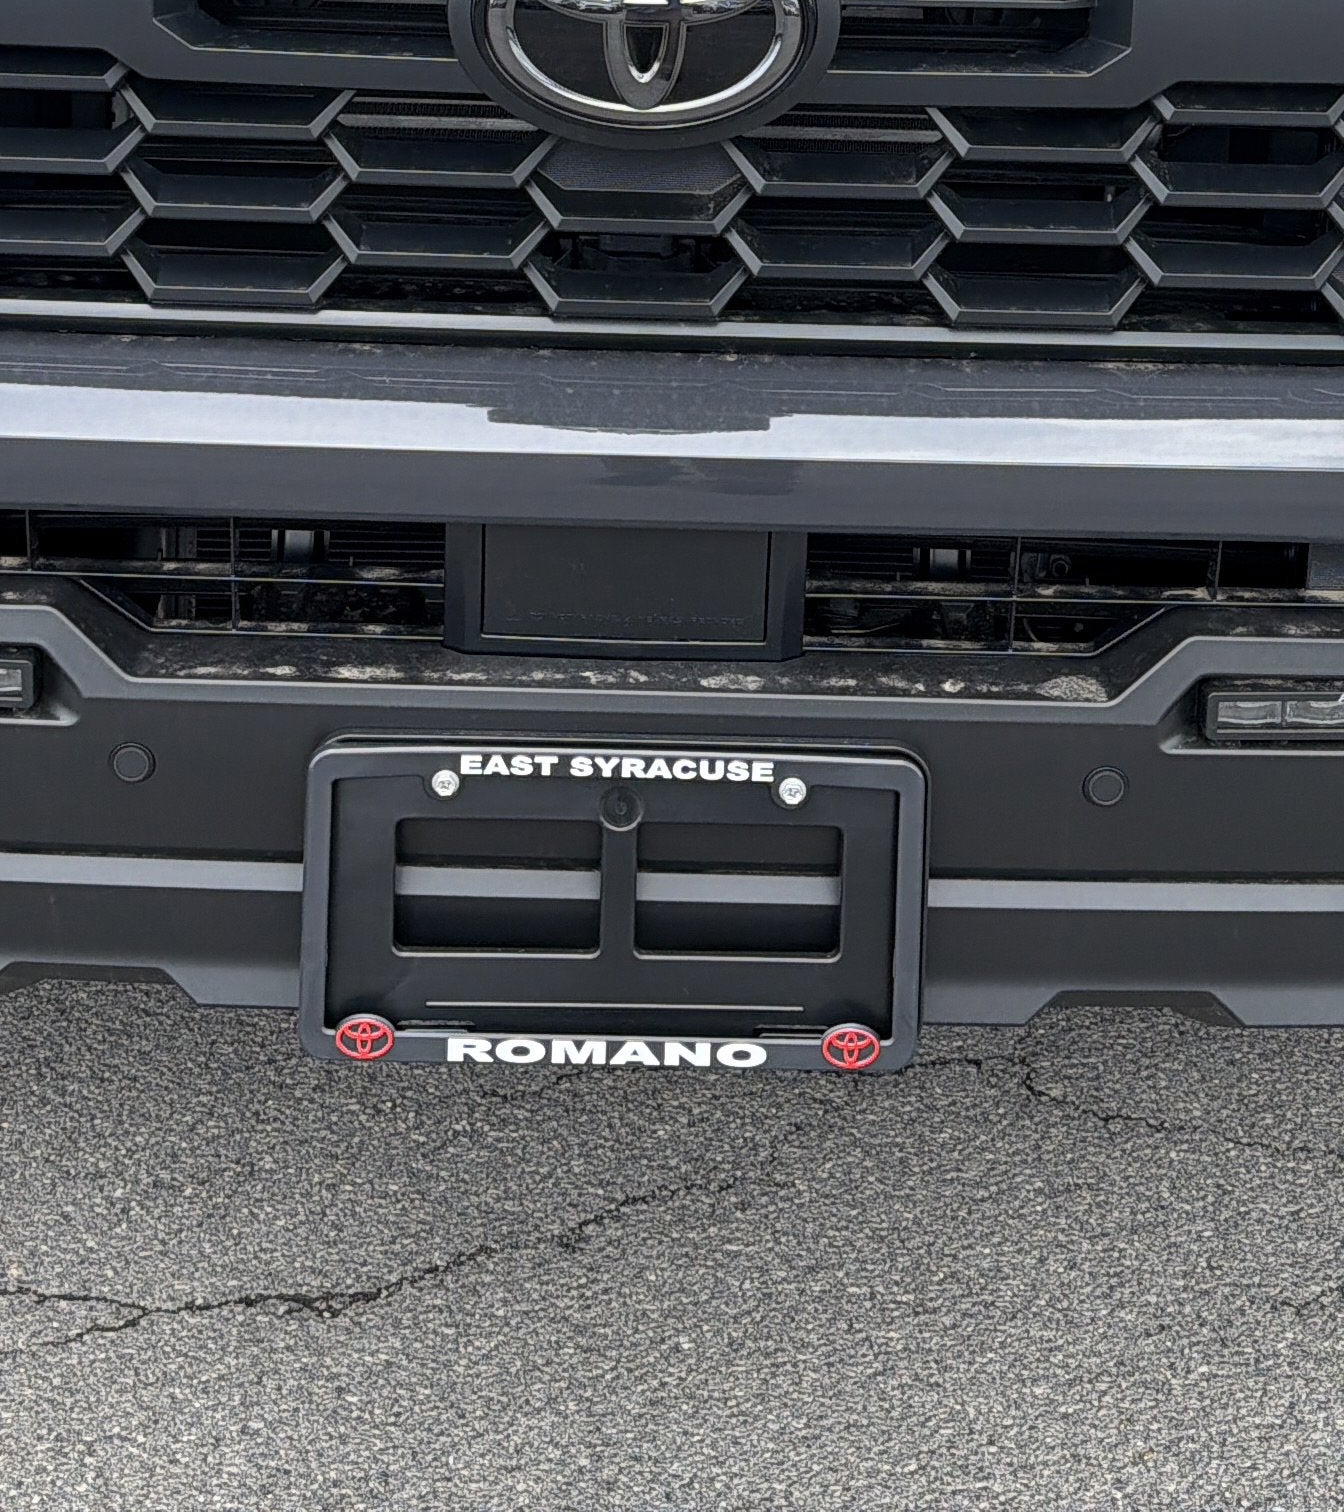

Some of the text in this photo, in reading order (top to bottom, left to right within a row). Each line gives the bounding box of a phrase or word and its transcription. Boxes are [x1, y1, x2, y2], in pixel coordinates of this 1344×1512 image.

[460, 754, 775, 783] EAST SYRACUSE
[446, 1037, 768, 1068] ROMANO
